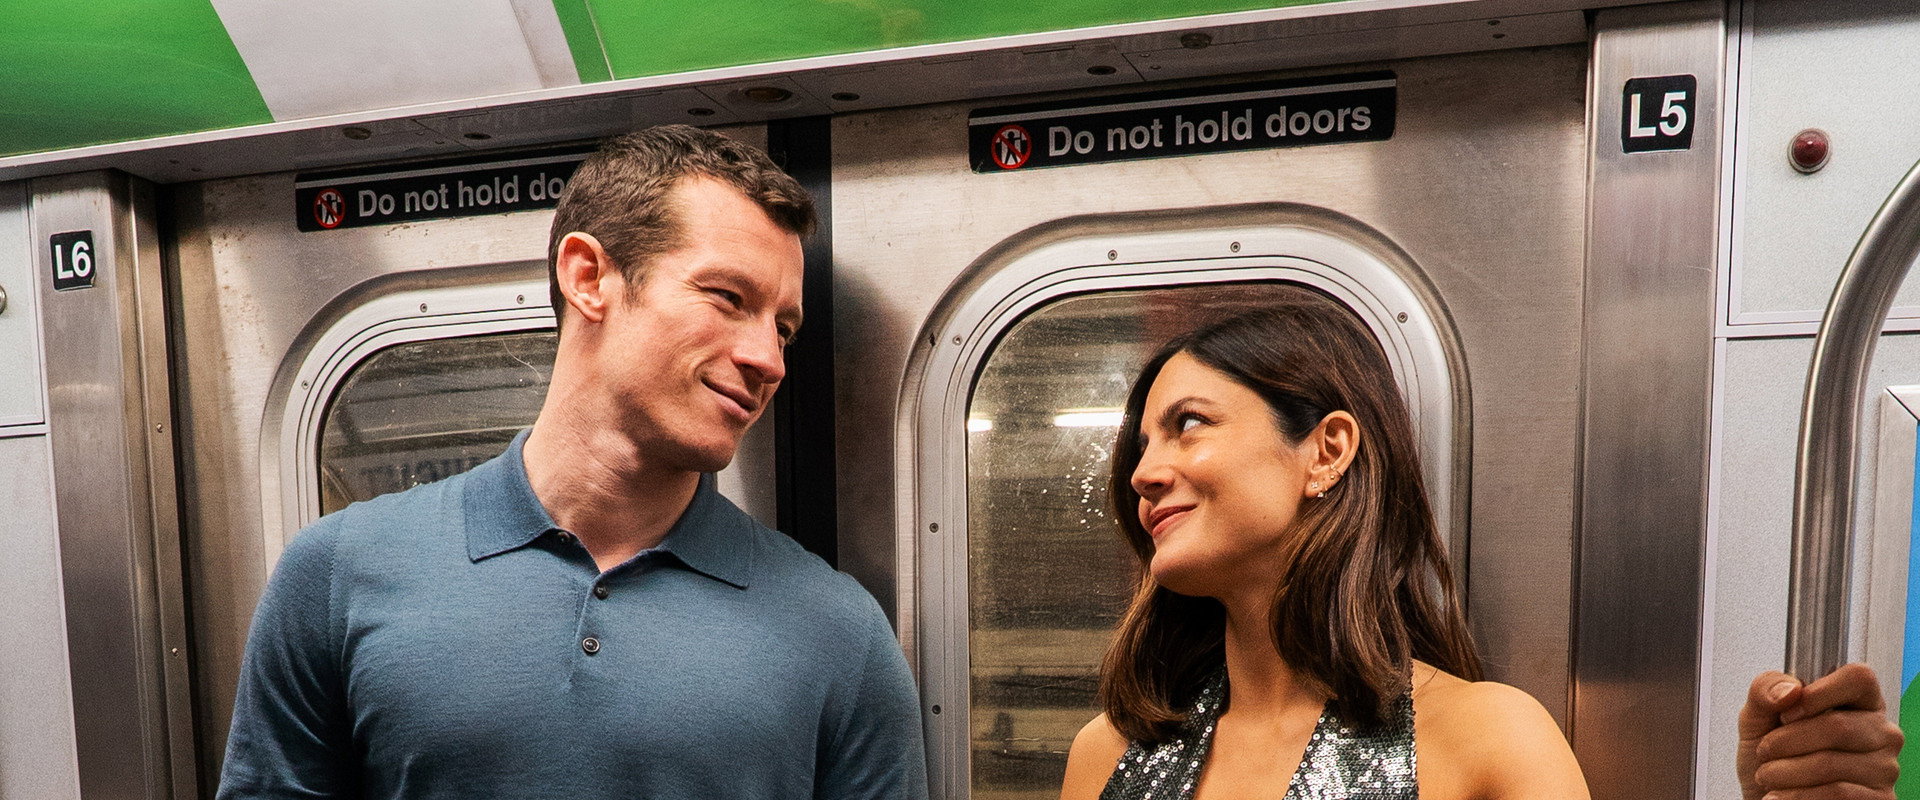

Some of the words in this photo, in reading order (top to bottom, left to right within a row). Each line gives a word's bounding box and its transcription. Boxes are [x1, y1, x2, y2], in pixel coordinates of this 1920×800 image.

[1048, 125, 1095, 157] Do
[1106, 118, 1163, 152] not
[1175, 109, 1253, 146] hold
[1265, 105, 1372, 138] doors
[1629, 91, 1687, 138] L5
[358, 189, 396, 217] Do
[404, 184, 449, 213] not
[457, 174, 519, 208] hold
[55, 240, 91, 280] L6
